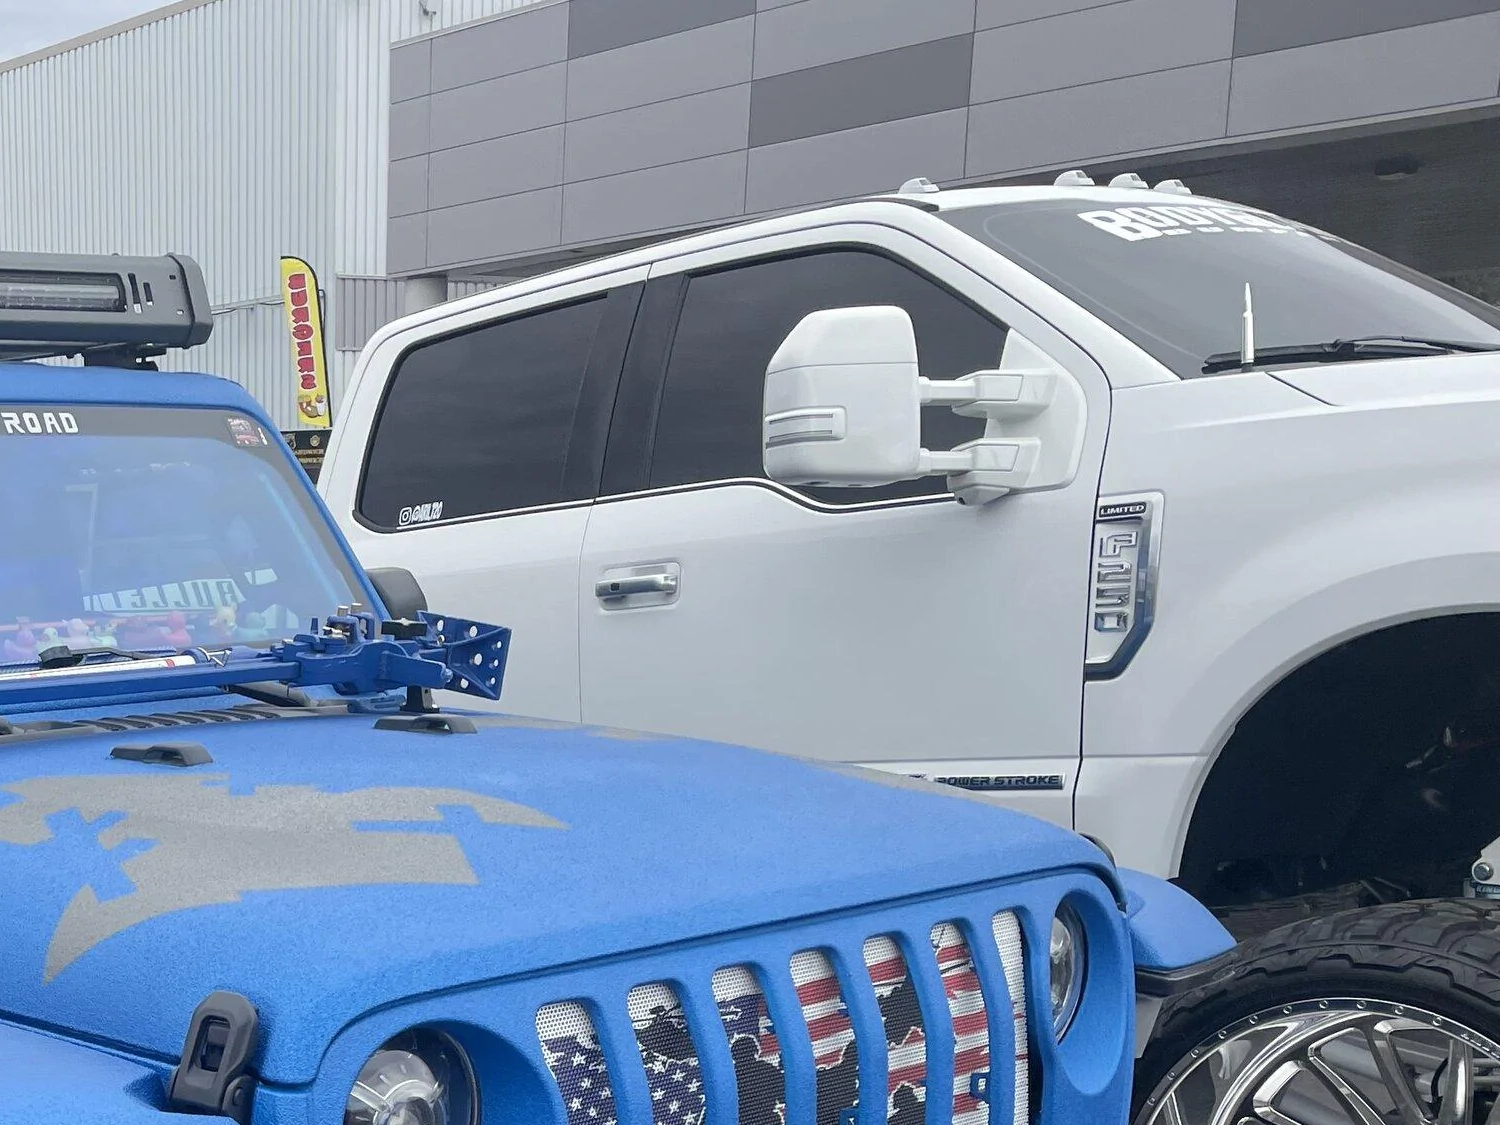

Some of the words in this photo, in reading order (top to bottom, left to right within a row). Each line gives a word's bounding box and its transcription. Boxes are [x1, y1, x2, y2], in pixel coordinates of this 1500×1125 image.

[1, 411, 79, 435] ROAD
[1100, 505, 1145, 515] LIMITED
[994, 775, 1059, 786] STROKE
